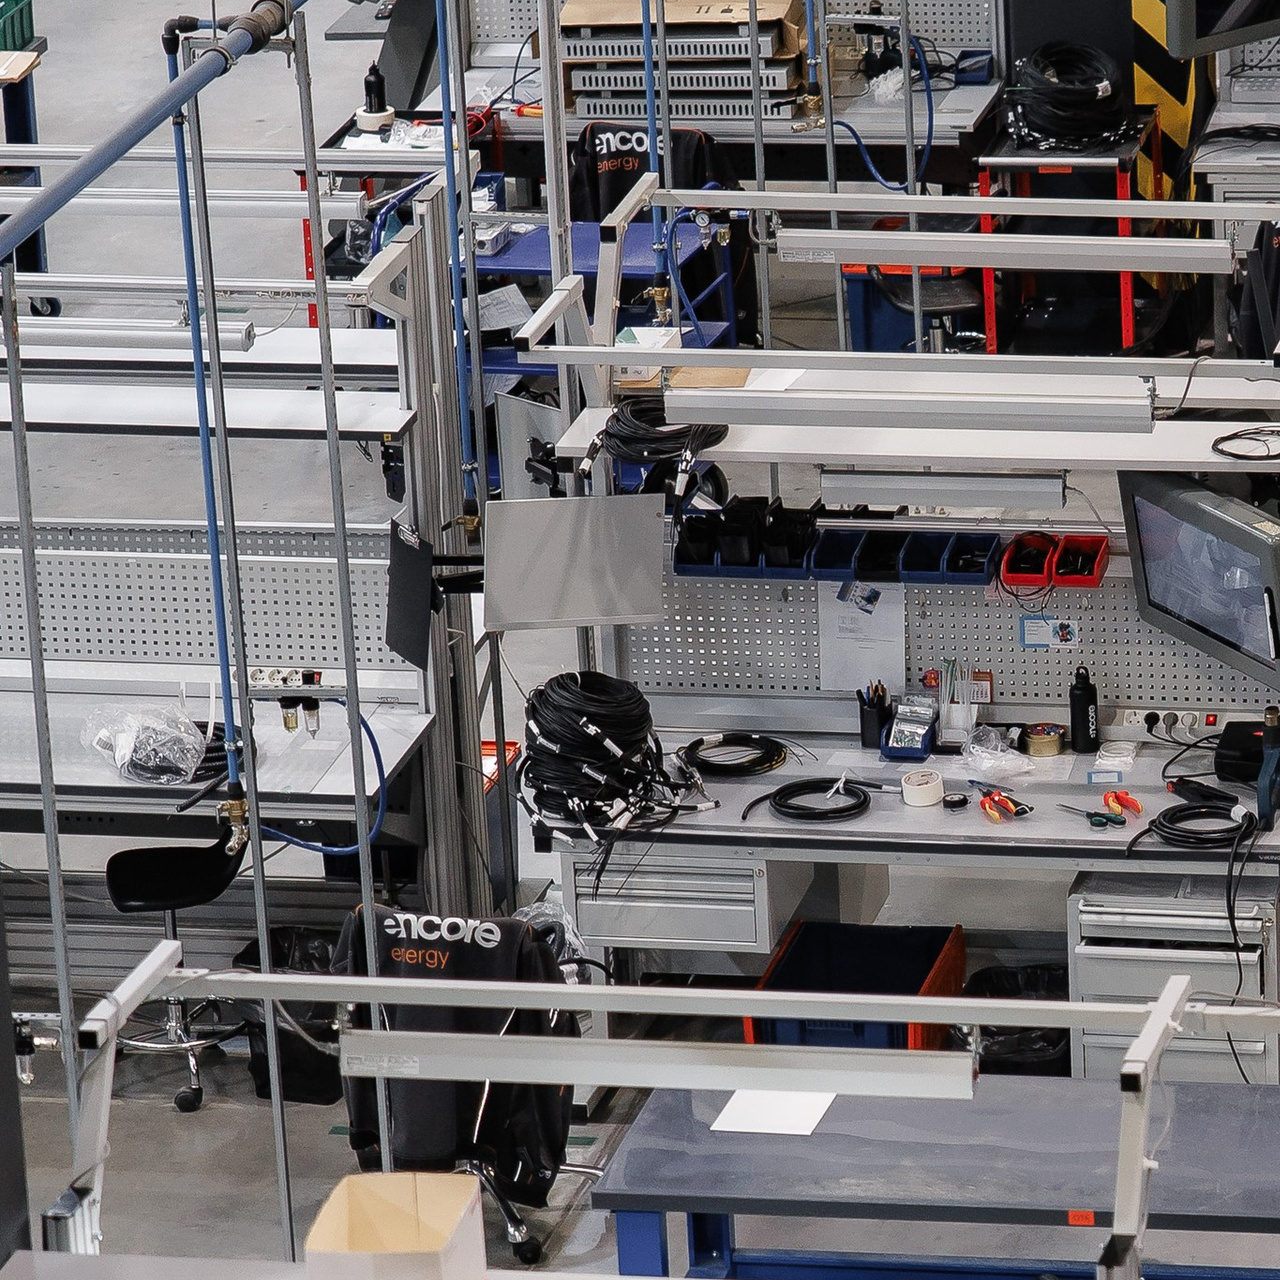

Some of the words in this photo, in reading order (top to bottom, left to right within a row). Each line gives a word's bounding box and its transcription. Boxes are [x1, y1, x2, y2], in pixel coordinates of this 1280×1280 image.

[1088, 705, 1096, 738] encore
[383, 913, 502, 948] encore
[391, 947, 450, 969] energy
